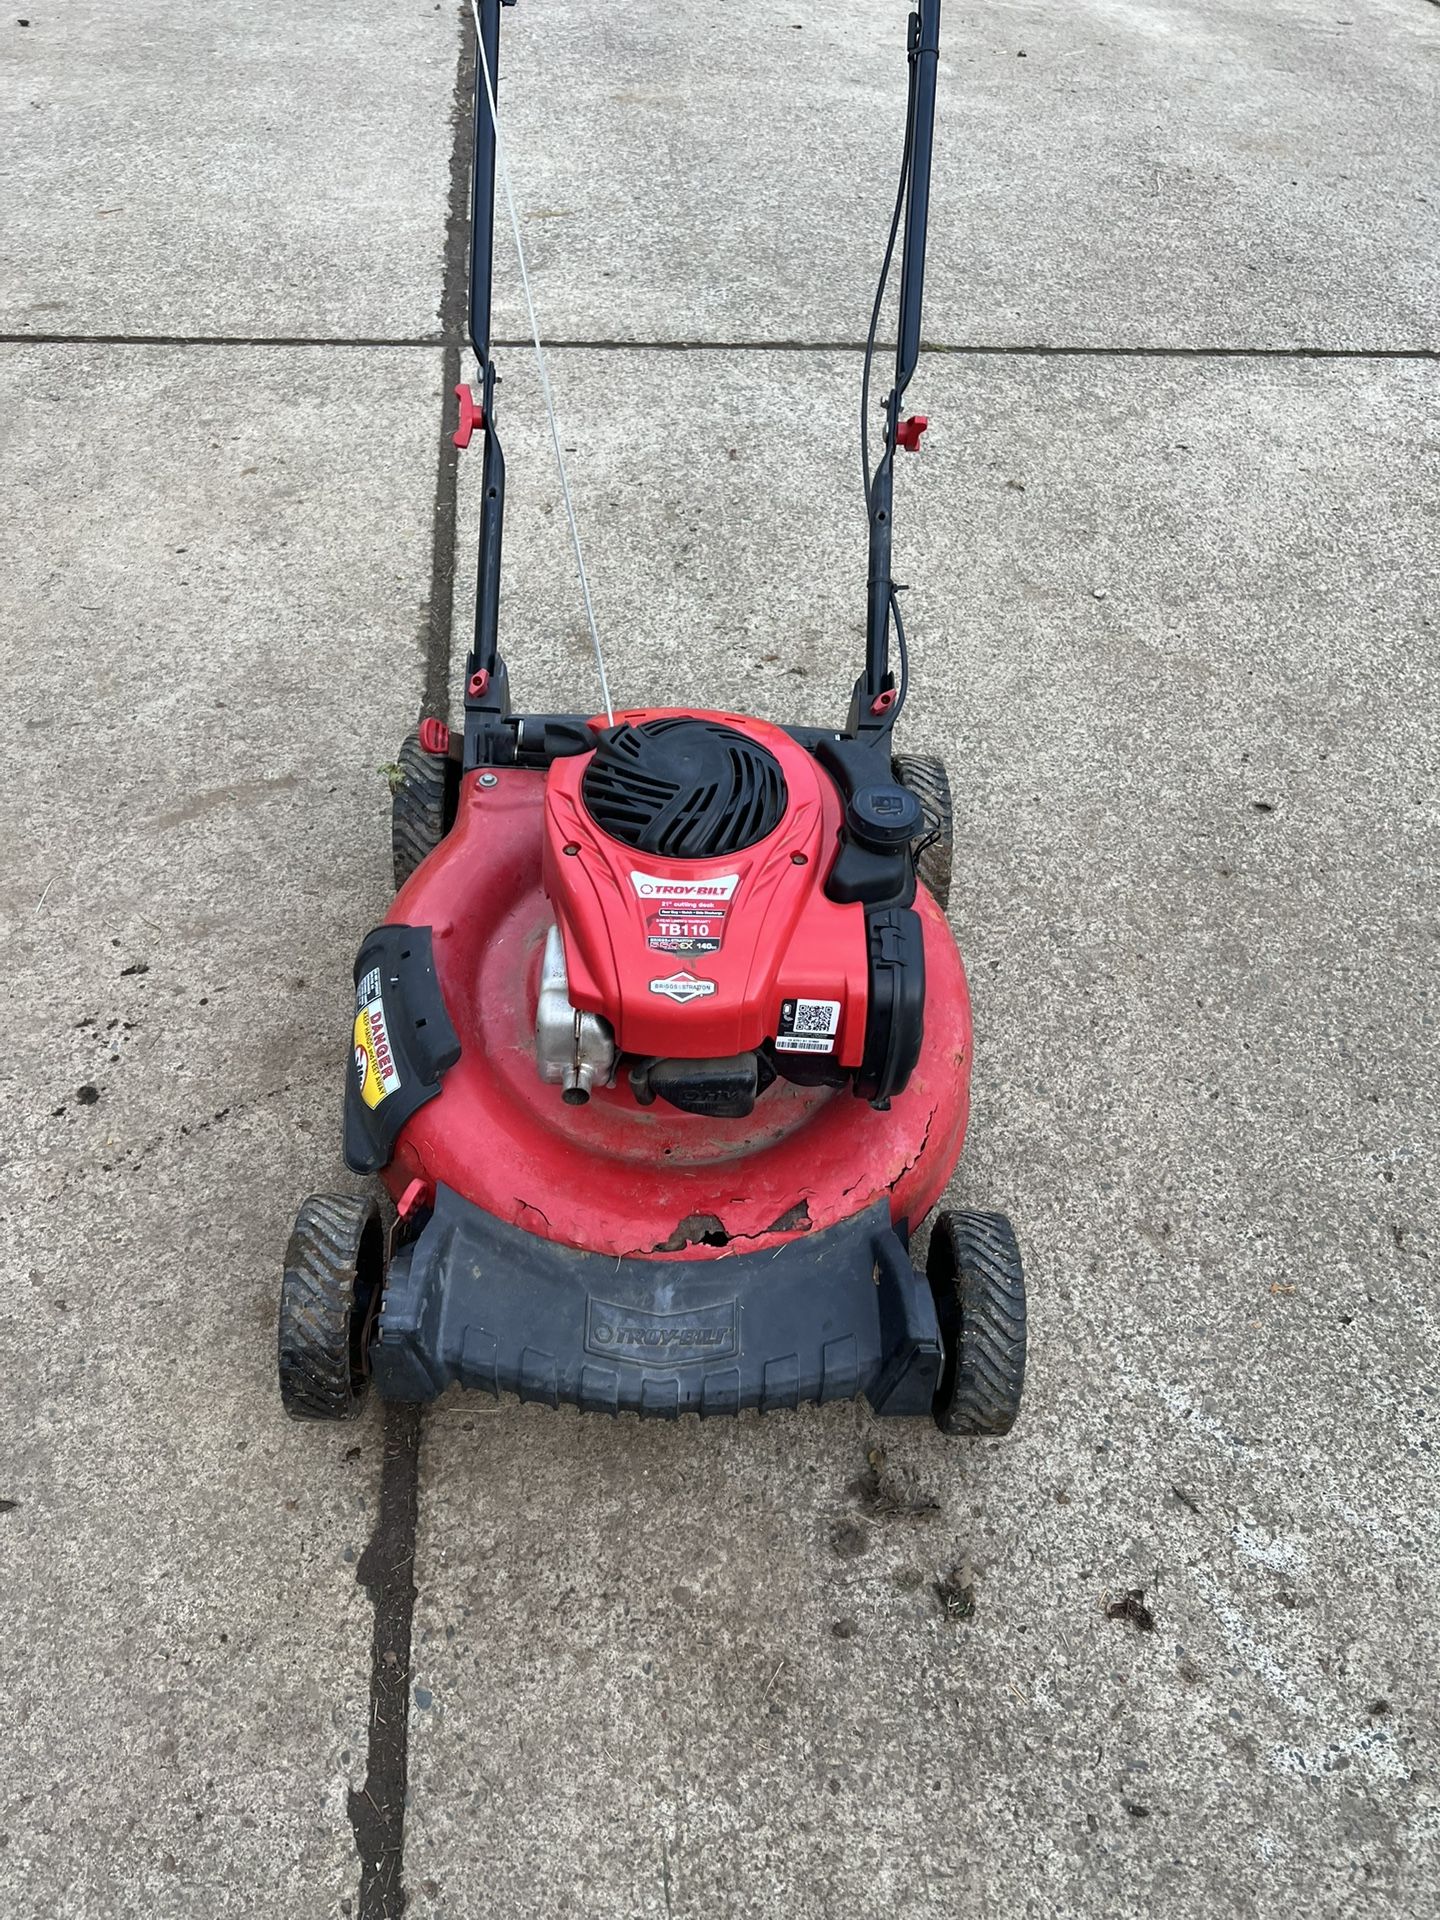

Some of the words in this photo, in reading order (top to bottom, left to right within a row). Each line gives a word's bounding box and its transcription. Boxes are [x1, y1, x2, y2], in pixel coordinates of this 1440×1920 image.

[654, 885, 728, 896] TROY-BILT
[673, 901, 697, 909] cutting
[659, 924, 709, 936] TB110
[370, 1011, 394, 1081] DANGER
[371, 1060, 380, 1075] FEET
[375, 1077, 385, 1094] AWAY
[616, 1327, 730, 1346] TROY-BILT
